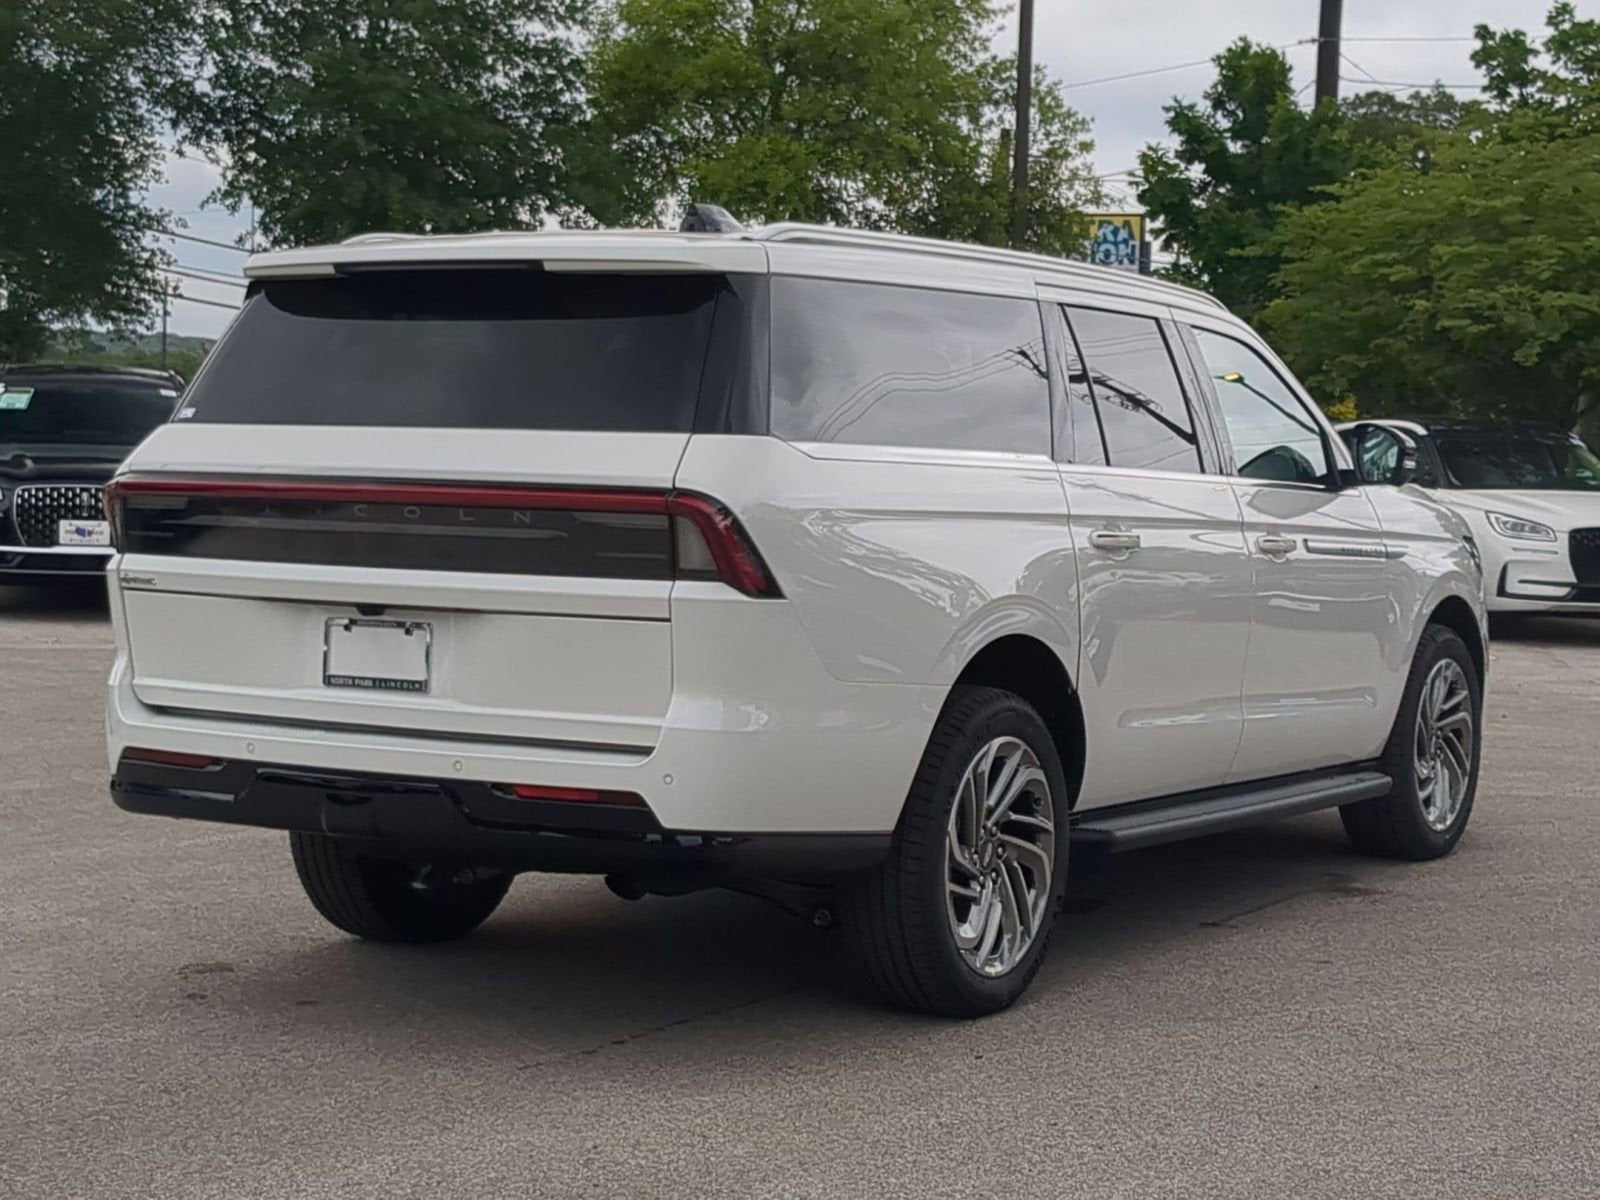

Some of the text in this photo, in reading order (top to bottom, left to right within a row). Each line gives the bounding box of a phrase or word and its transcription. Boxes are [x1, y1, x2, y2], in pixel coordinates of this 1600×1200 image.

[330, 677, 421, 689] NORTH PARK LINCOLN
